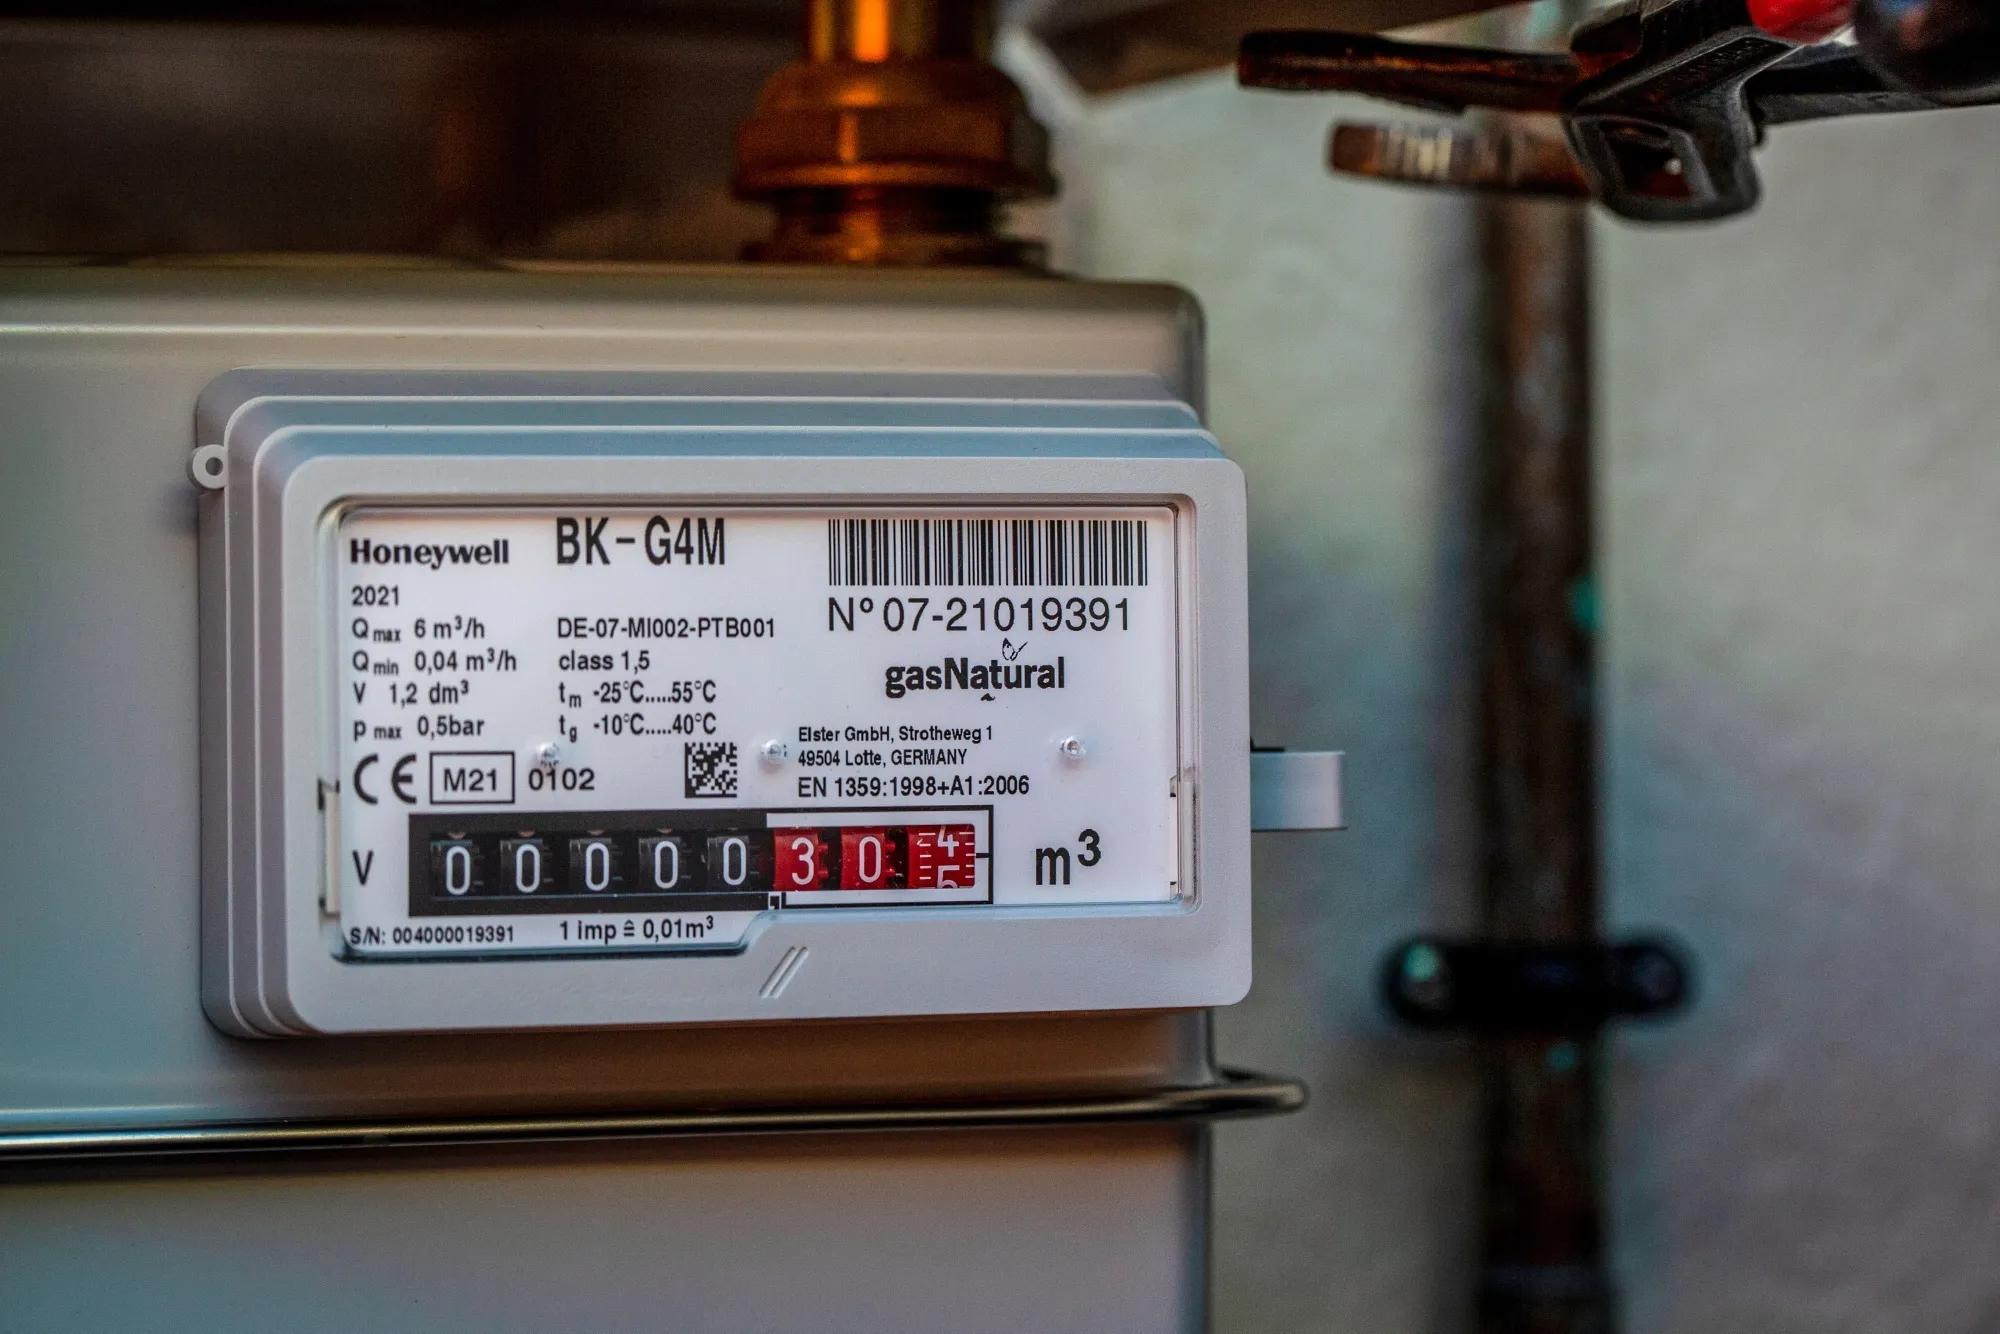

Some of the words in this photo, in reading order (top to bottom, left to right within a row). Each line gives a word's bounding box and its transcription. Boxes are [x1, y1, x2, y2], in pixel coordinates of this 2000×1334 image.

[350, 539, 508, 570] Honeywell
[352, 586, 398, 606] 2021
[884, 597, 1127, 631] 07-21019391
[415, 619, 426, 638] 6
[558, 617, 773, 637] DE-07-MI002-PTB001
[415, 651, 457, 673] 0,04
[559, 650, 613, 670] class
[622, 650, 649, 674] 1,5
[885, 656, 1065, 698] gasNatural
[354, 683, 365, 703] V
[391, 683, 417, 706] 1,2
[418, 715, 484, 738] 0,5bar
[799, 727, 840, 741] Elster
[845, 726, 893, 743] GmbH,
[899, 726, 981, 744] Strotheweg
[985, 725, 993, 740] 1
[799, 750, 840, 766] 49504
[846, 750, 886, 767] Lotte,
[891, 749, 967, 765] GERMANY
[354, 753, 417, 804] CE
[444, 769, 496, 791] M21
[528, 768, 595, 791] 0102
[799, 777, 826, 797] EN
[353, 851, 373, 885] V
[350, 926, 387, 946] S/N:
[393, 926, 513, 943] 004000019391
[559, 922, 570, 940] 1
[578, 921, 616, 945] imp
